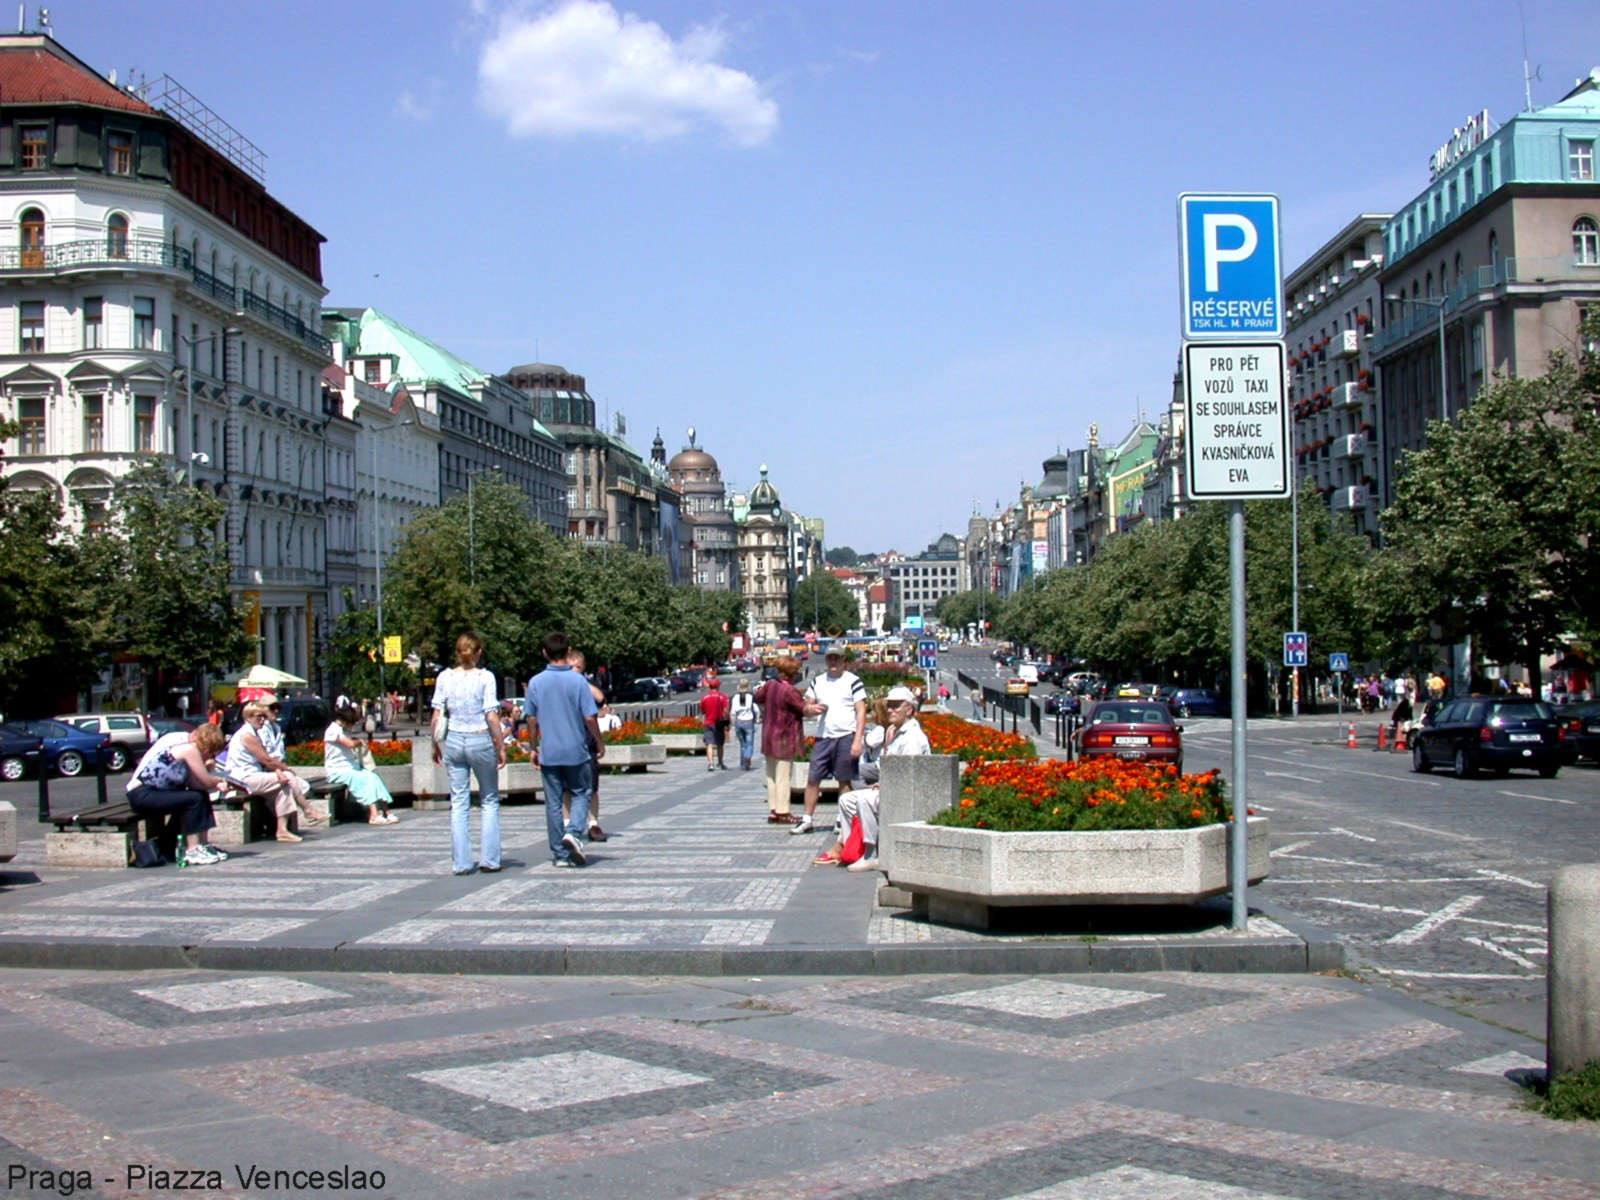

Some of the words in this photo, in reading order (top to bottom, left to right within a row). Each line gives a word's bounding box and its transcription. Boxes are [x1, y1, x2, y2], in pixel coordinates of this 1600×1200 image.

[1203, 213, 1258, 292] P
[1191, 297, 1275, 318] RÉSERVÉ
[1194, 319, 1211, 328] TSK
[1214, 319, 1228, 328] HL.
[1244, 319, 1274, 328] PRAHY
[1210, 357, 1233, 371] PRO
[1240, 354, 1260, 371] PĚT
[1205, 376, 1234, 394] VOZŮ
[1244, 379, 1269, 393] TAXI
[1196, 403, 1211, 417] SE
[1213, 401, 1278, 416] SOUHLASEM
[1214, 421, 1262, 438] SPRÁVCE
[1202, 443, 1275, 460] KVASNIČKOVÁ
[1229, 468, 1249, 483] EVA
